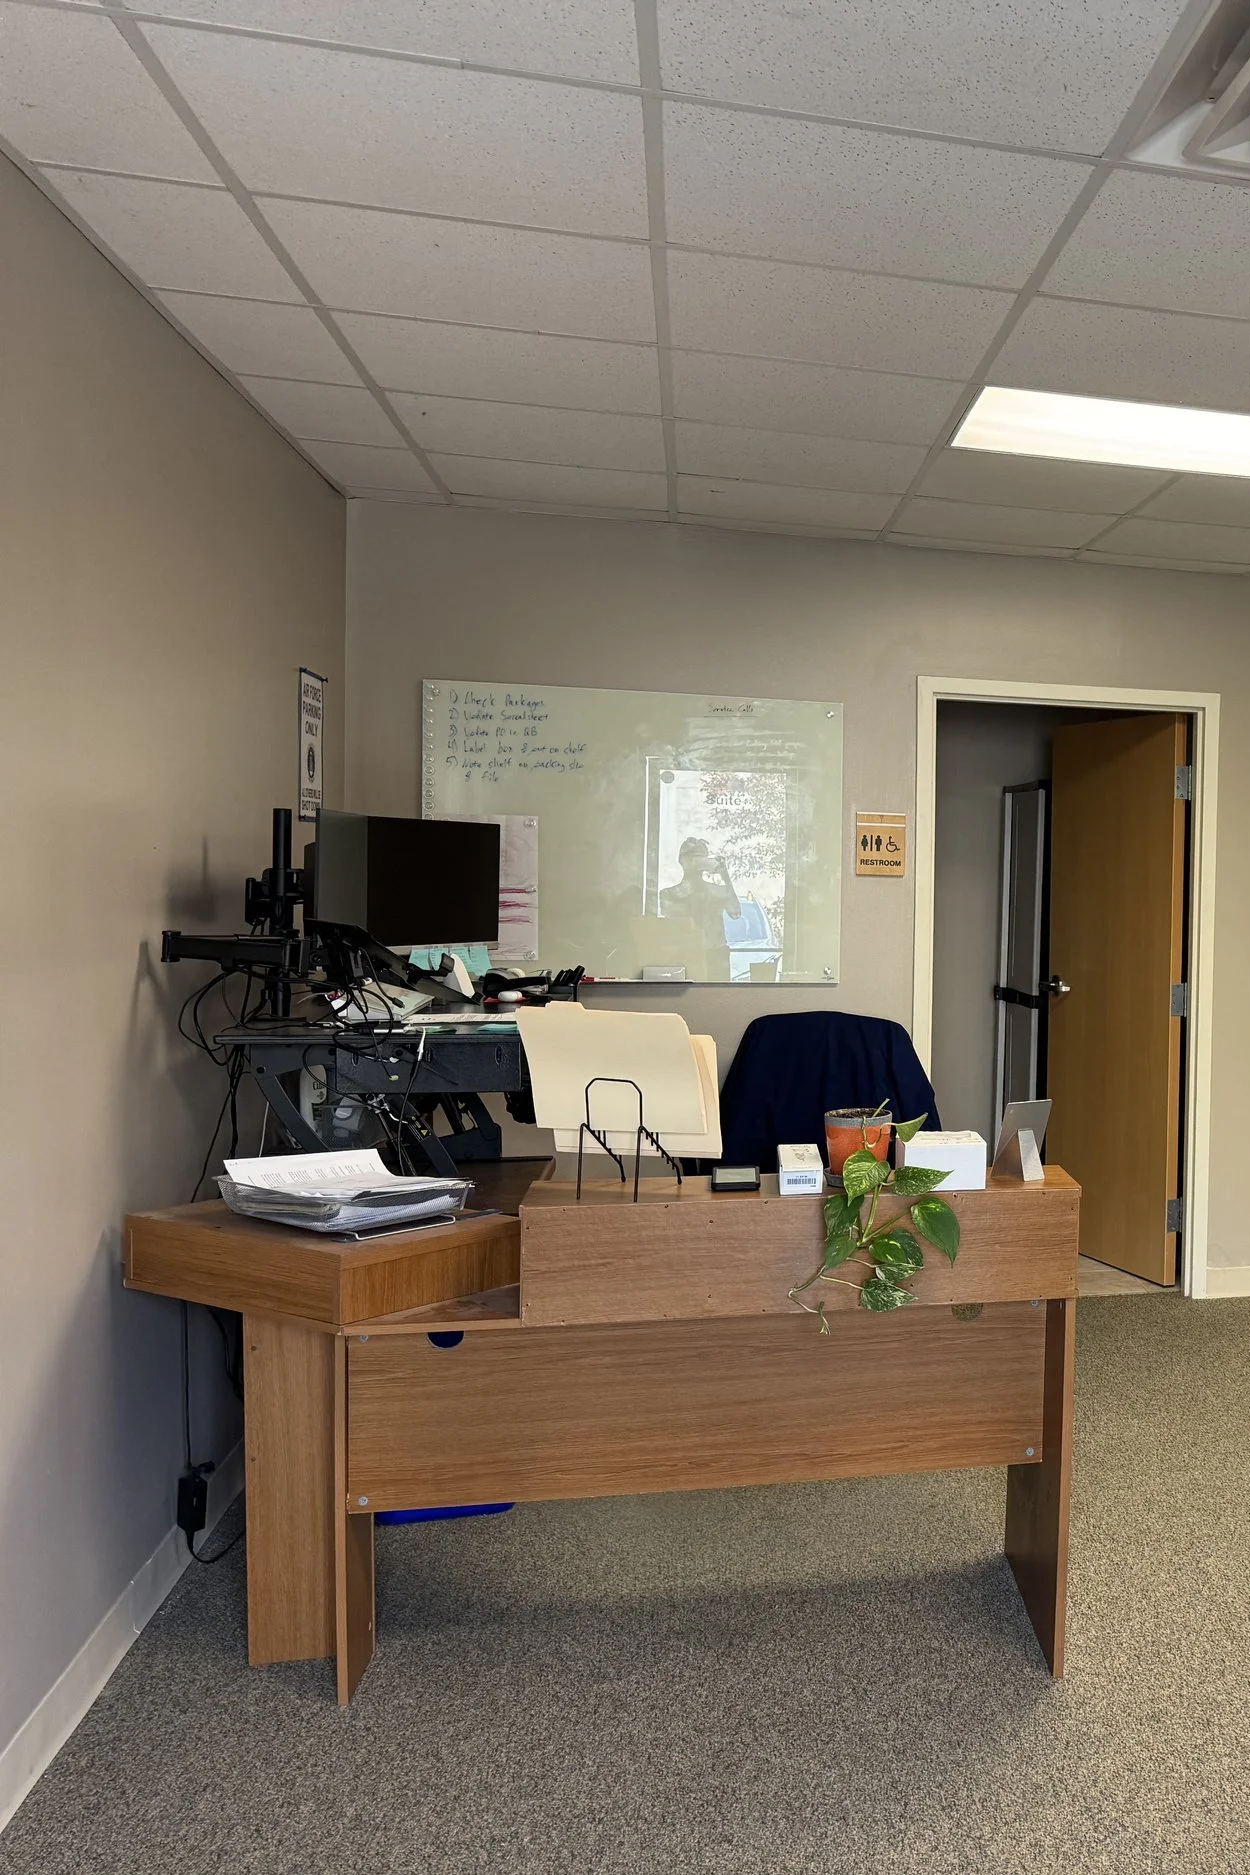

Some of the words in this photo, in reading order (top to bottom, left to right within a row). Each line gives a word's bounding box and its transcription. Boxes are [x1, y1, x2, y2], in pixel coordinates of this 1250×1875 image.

[310, 685, 321, 703] FORCE
[464, 691, 496, 707] Check
[505, 694, 545, 710] Packages
[303, 700, 321, 720] PARKING
[305, 721, 319, 737] ONLY
[463, 740, 487, 754] Label
[497, 741, 513, 754] box
[488, 757, 513, 769] shelf
[705, 793, 742, 806] Suite
[860, 858, 902, 867] RESTROOM
